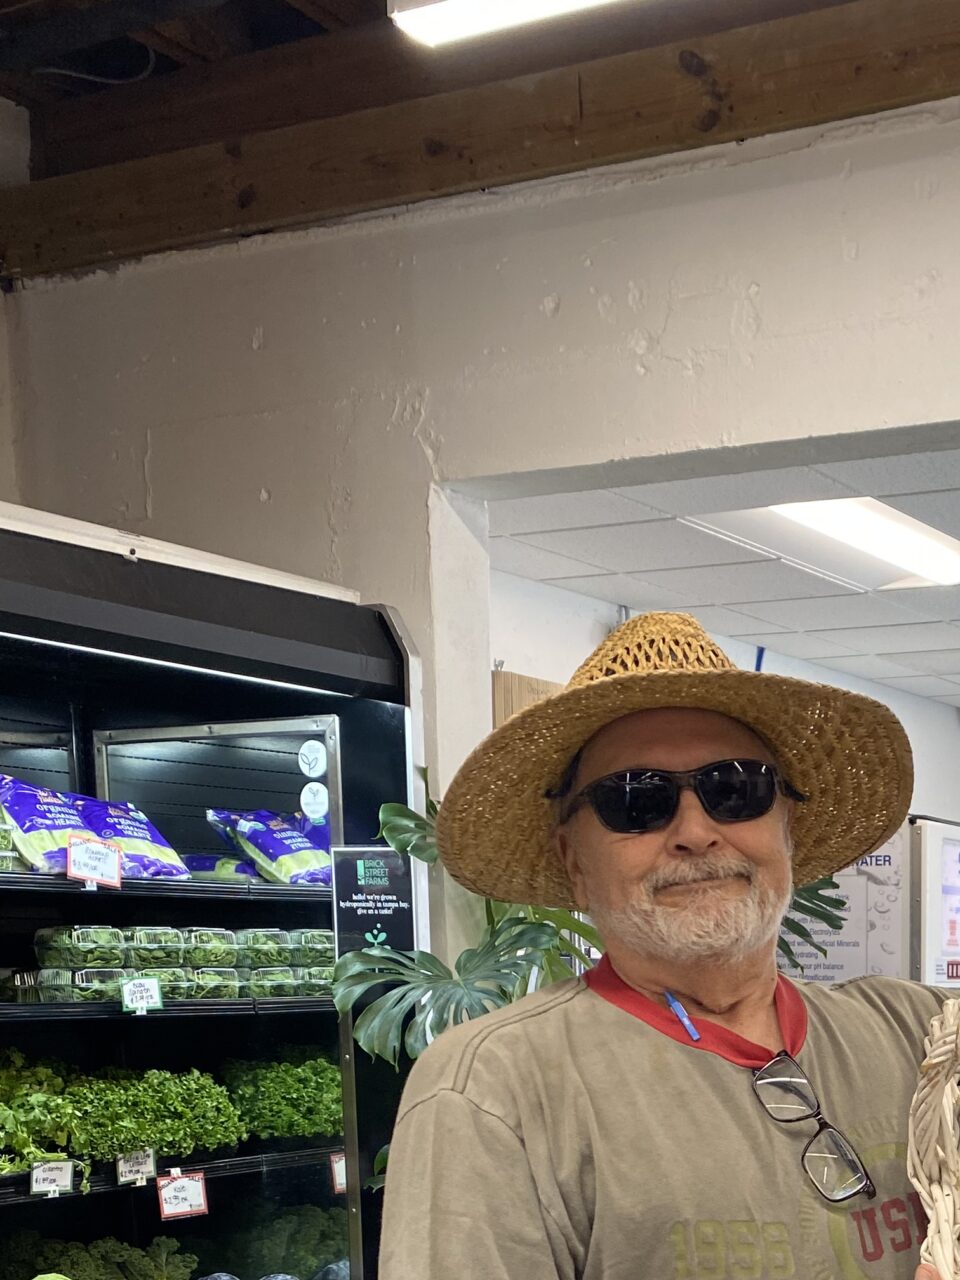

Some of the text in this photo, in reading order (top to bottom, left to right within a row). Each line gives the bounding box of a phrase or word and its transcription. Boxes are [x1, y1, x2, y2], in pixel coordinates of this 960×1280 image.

[365, 860, 385, 868] BRICK
[365, 868, 389, 877] STREET
[365, 877, 389, 885] FARMS
[836, 940, 860, 948] Minerals
